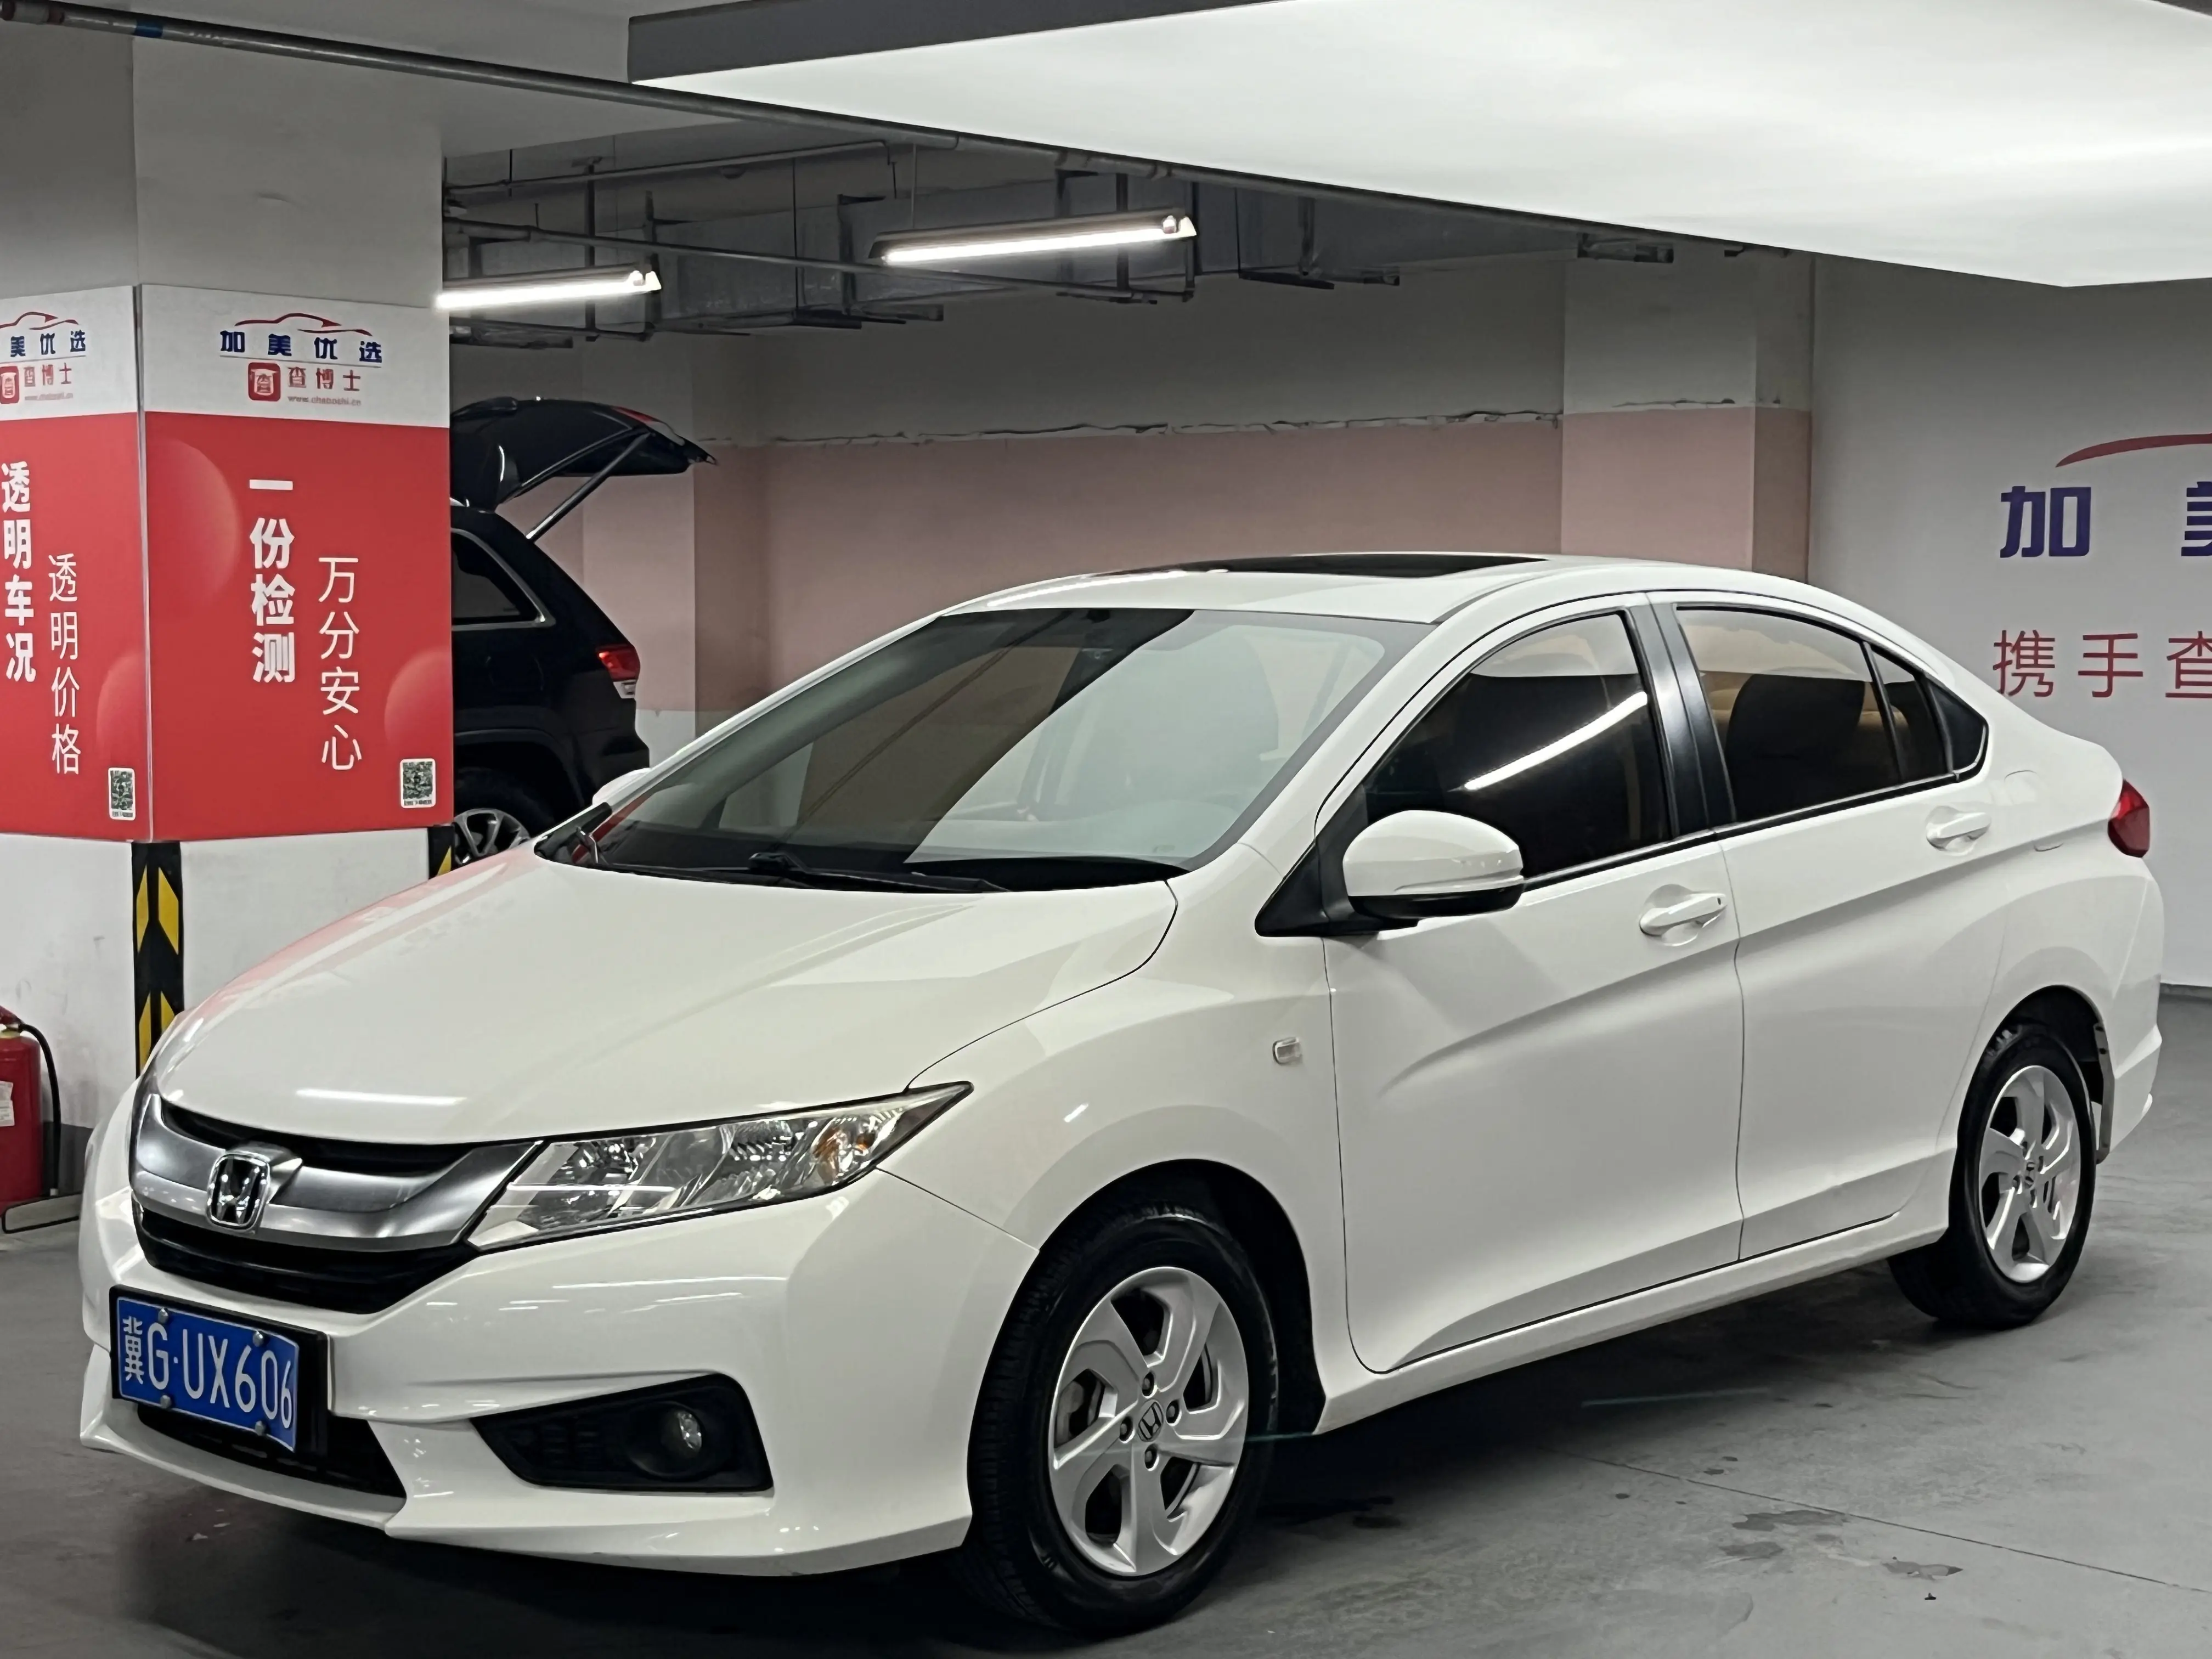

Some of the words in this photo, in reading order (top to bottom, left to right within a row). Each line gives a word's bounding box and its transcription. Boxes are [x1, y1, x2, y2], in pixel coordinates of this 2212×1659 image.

[10, 330, 86, 357] 美优选
[221, 330, 382, 363] 加美优选
[287, 366, 361, 391] 查博士
[1, 461, 36, 682] 透明车况
[48, 552, 81, 775] 透明价格
[249, 479, 295, 683] 一份检测
[318, 557, 362, 771] 万分安心
